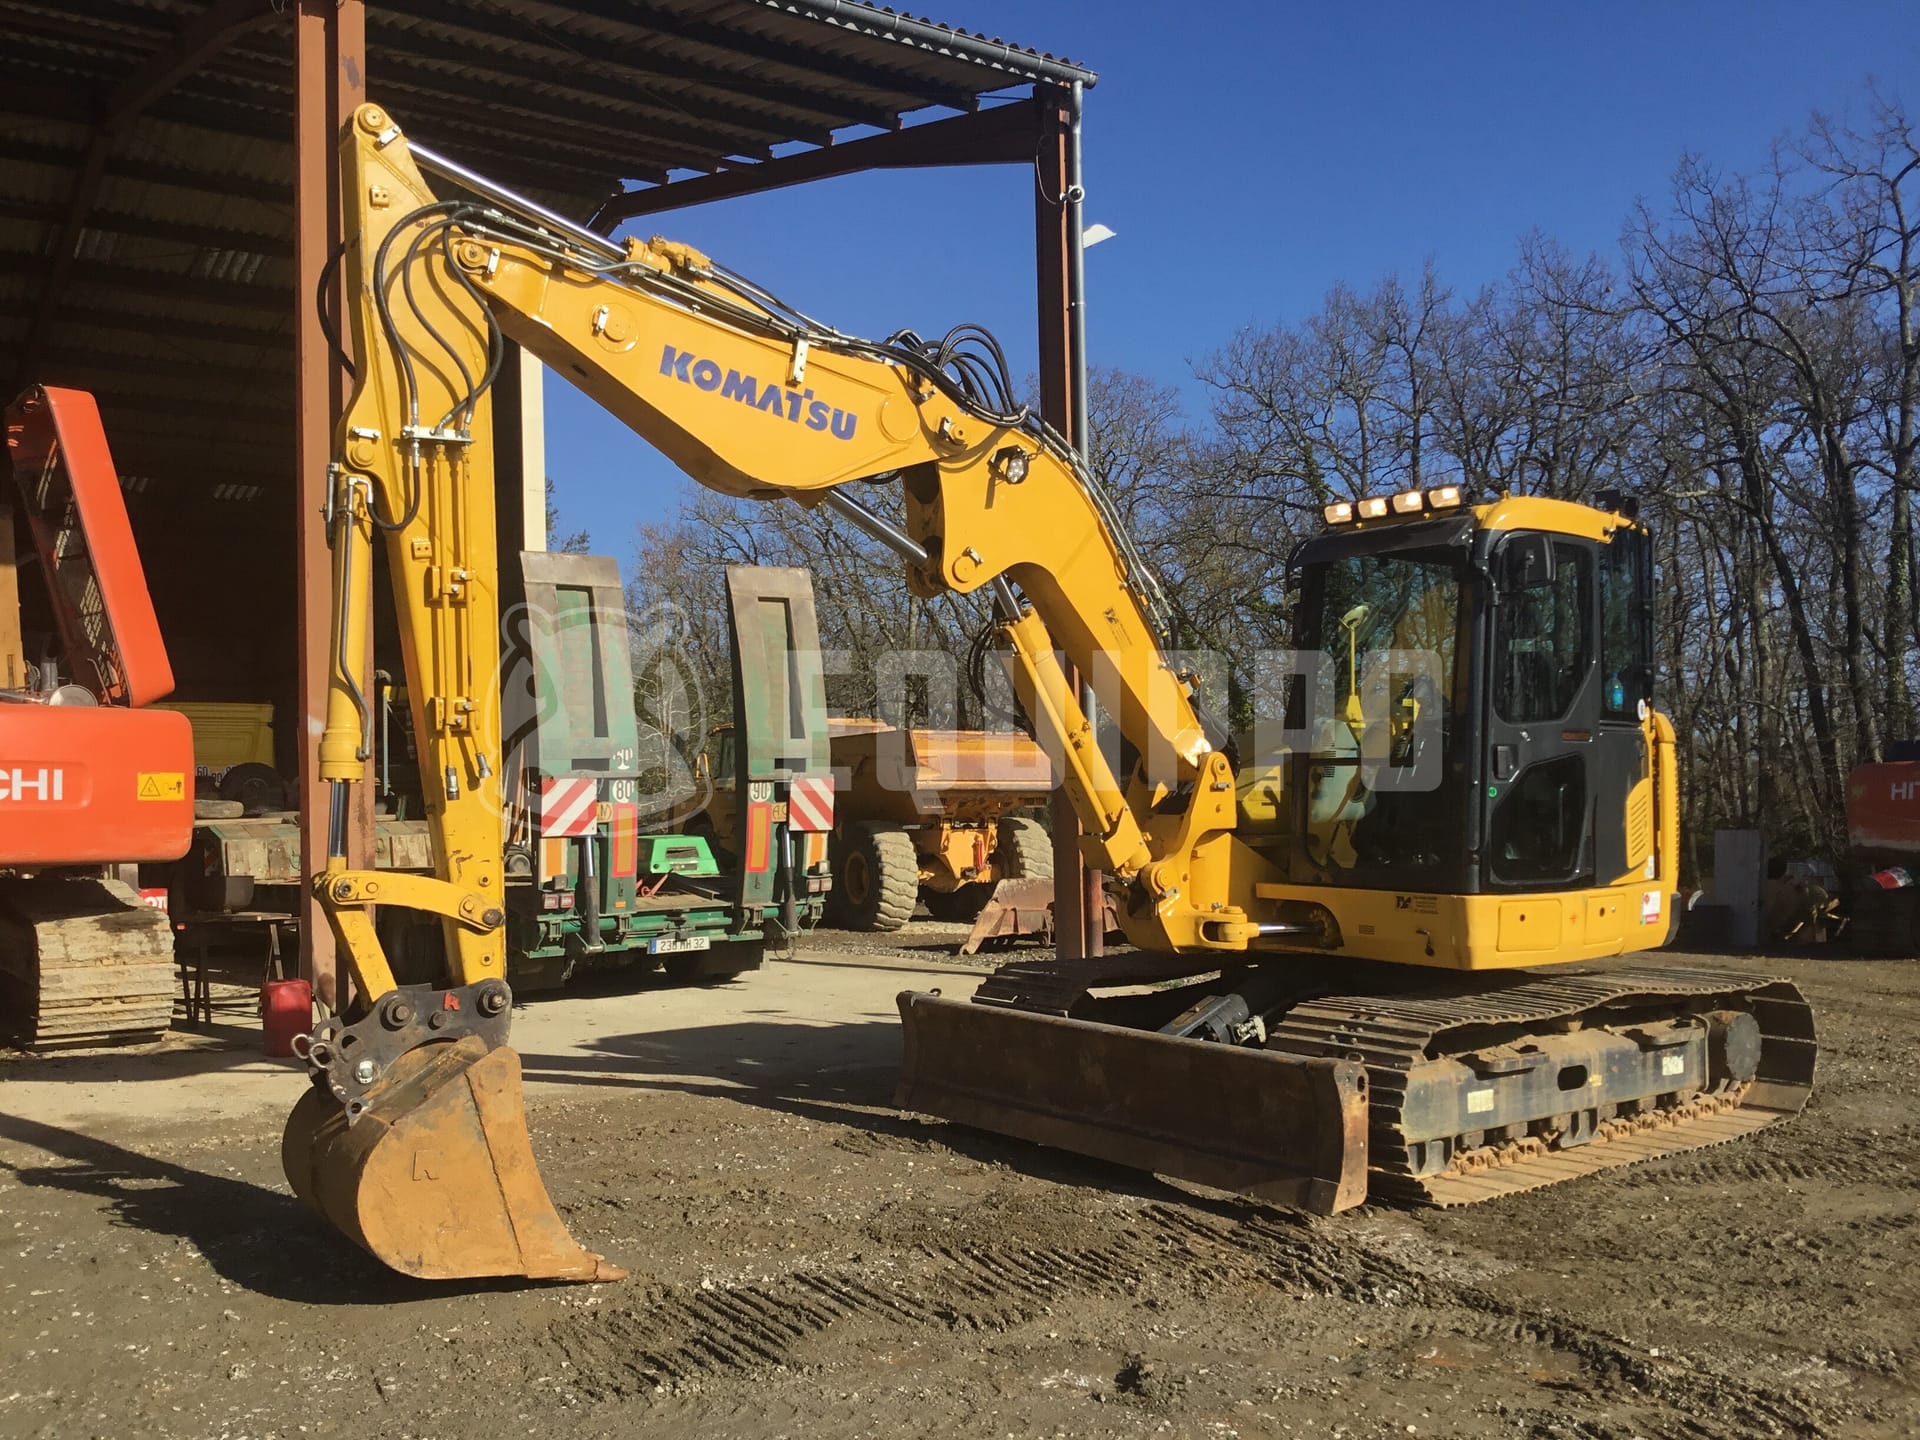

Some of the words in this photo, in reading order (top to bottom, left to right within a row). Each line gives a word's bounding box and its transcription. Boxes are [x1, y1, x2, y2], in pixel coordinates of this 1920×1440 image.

[659, 344, 858, 441] KOMATSU
[616, 780, 632, 800] 80
[753, 782, 768, 800] 90
[694, 937, 705, 949] 32
